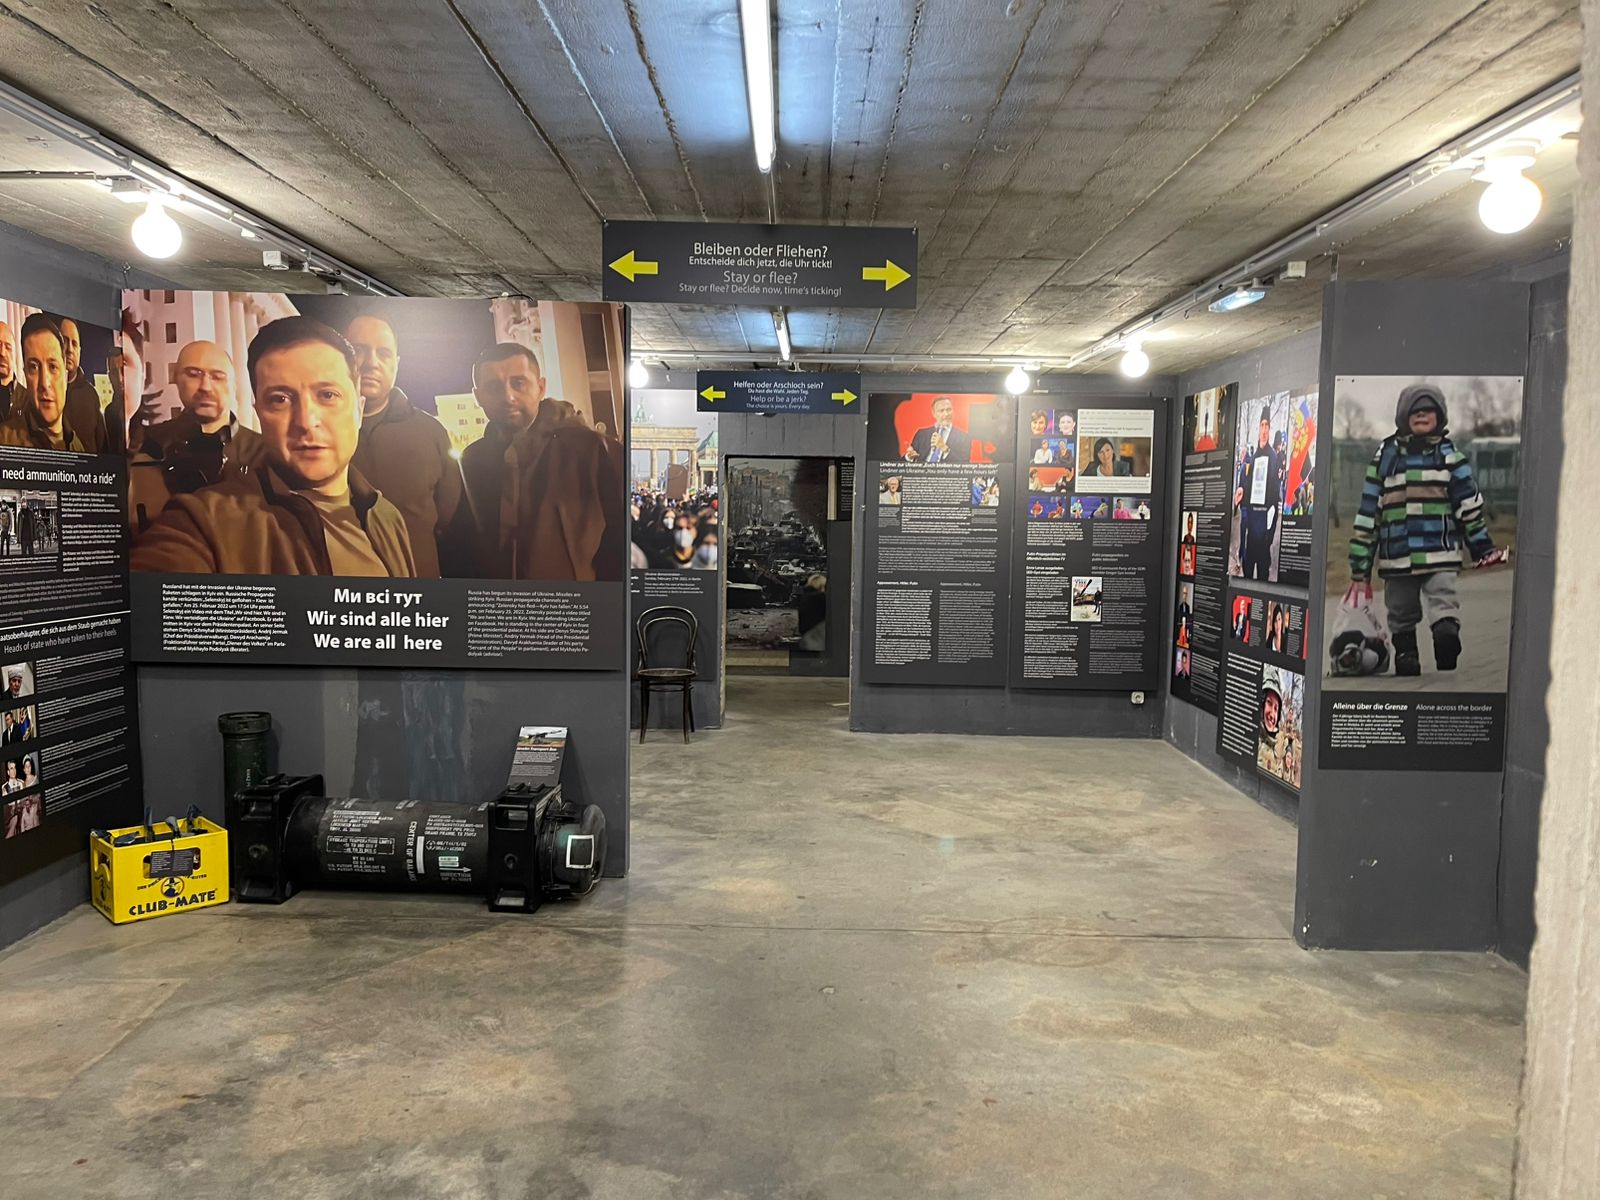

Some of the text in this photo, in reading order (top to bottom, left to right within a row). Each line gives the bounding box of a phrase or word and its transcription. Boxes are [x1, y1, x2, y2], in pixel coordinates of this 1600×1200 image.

[694, 242, 828, 258] Bleiben oder Fliehen?
[689, 256, 833, 269] Entscheide dich jetzt, die Uhr tickt!
[723, 270, 798, 286] Stay or flee?
[679, 283, 697, 294] Stay
[709, 283, 729, 293] flee?
[731, 284, 761, 294] Decide
[762, 286, 782, 295] now,
[811, 286, 842, 298] ticking!
[733, 380, 824, 390] Helfen oder Arschloch sein?
[750, 395, 766, 403] Help
[775, 395, 785, 403] be
[791, 395, 807, 404] jerk?
[2, 467, 25, 480] need
[26, 469, 77, 485] ammunition,
[79, 473, 92, 483] not
[92, 474, 98, 484] a
[334, 588, 423, 608] Ми всі тут
[306, 610, 449, 628] Wir sind alle hier
[4, 642, 22, 654] Heads
[23, 641, 30, 651] of
[30, 640, 44, 650] state
[45, 637, 57, 647] who
[57, 635, 70, 645] have
[71, 633, 86, 643] taken
[92, 630, 104, 639] their
[104, 627, 117, 637] heels
[313, 633, 443, 650] We are all here
[1332, 702, 1408, 711] Alleine über die Grenze
[1416, 703, 1435, 711] Alone
[1470, 704, 1493, 712] border
[406, 821, 418, 846] CENTER
[129, 890, 216, 916] CLUB-MATE
